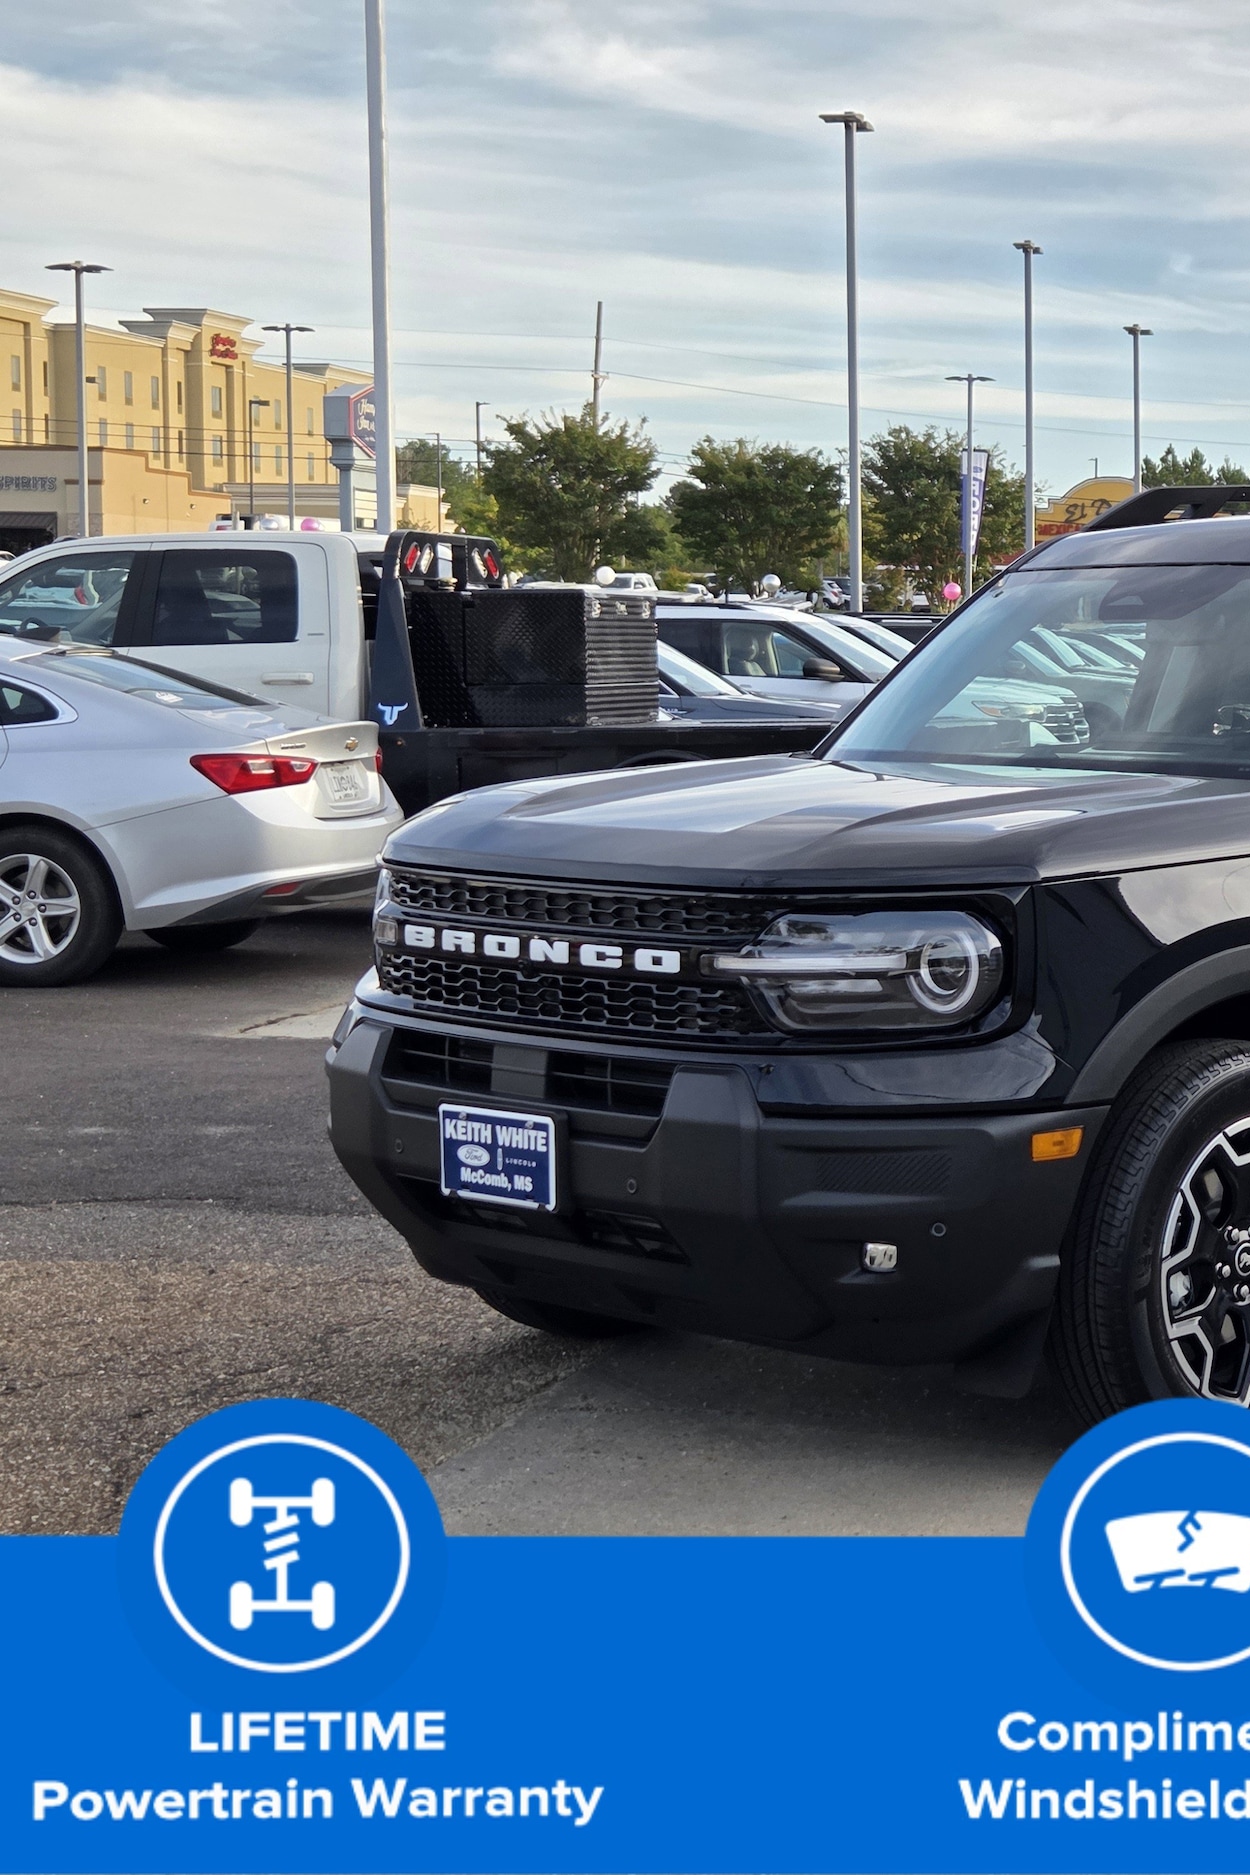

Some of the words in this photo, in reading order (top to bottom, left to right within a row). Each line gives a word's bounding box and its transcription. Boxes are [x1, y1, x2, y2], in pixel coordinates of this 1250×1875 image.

[404, 924, 681, 974] BRONCO
[444, 1118, 492, 1145] KEITH
[495, 1124, 548, 1153] WHITE
[463, 1147, 484, 1162] Ford
[460, 1166, 512, 1192] McComb,
[513, 1174, 534, 1193] MS
